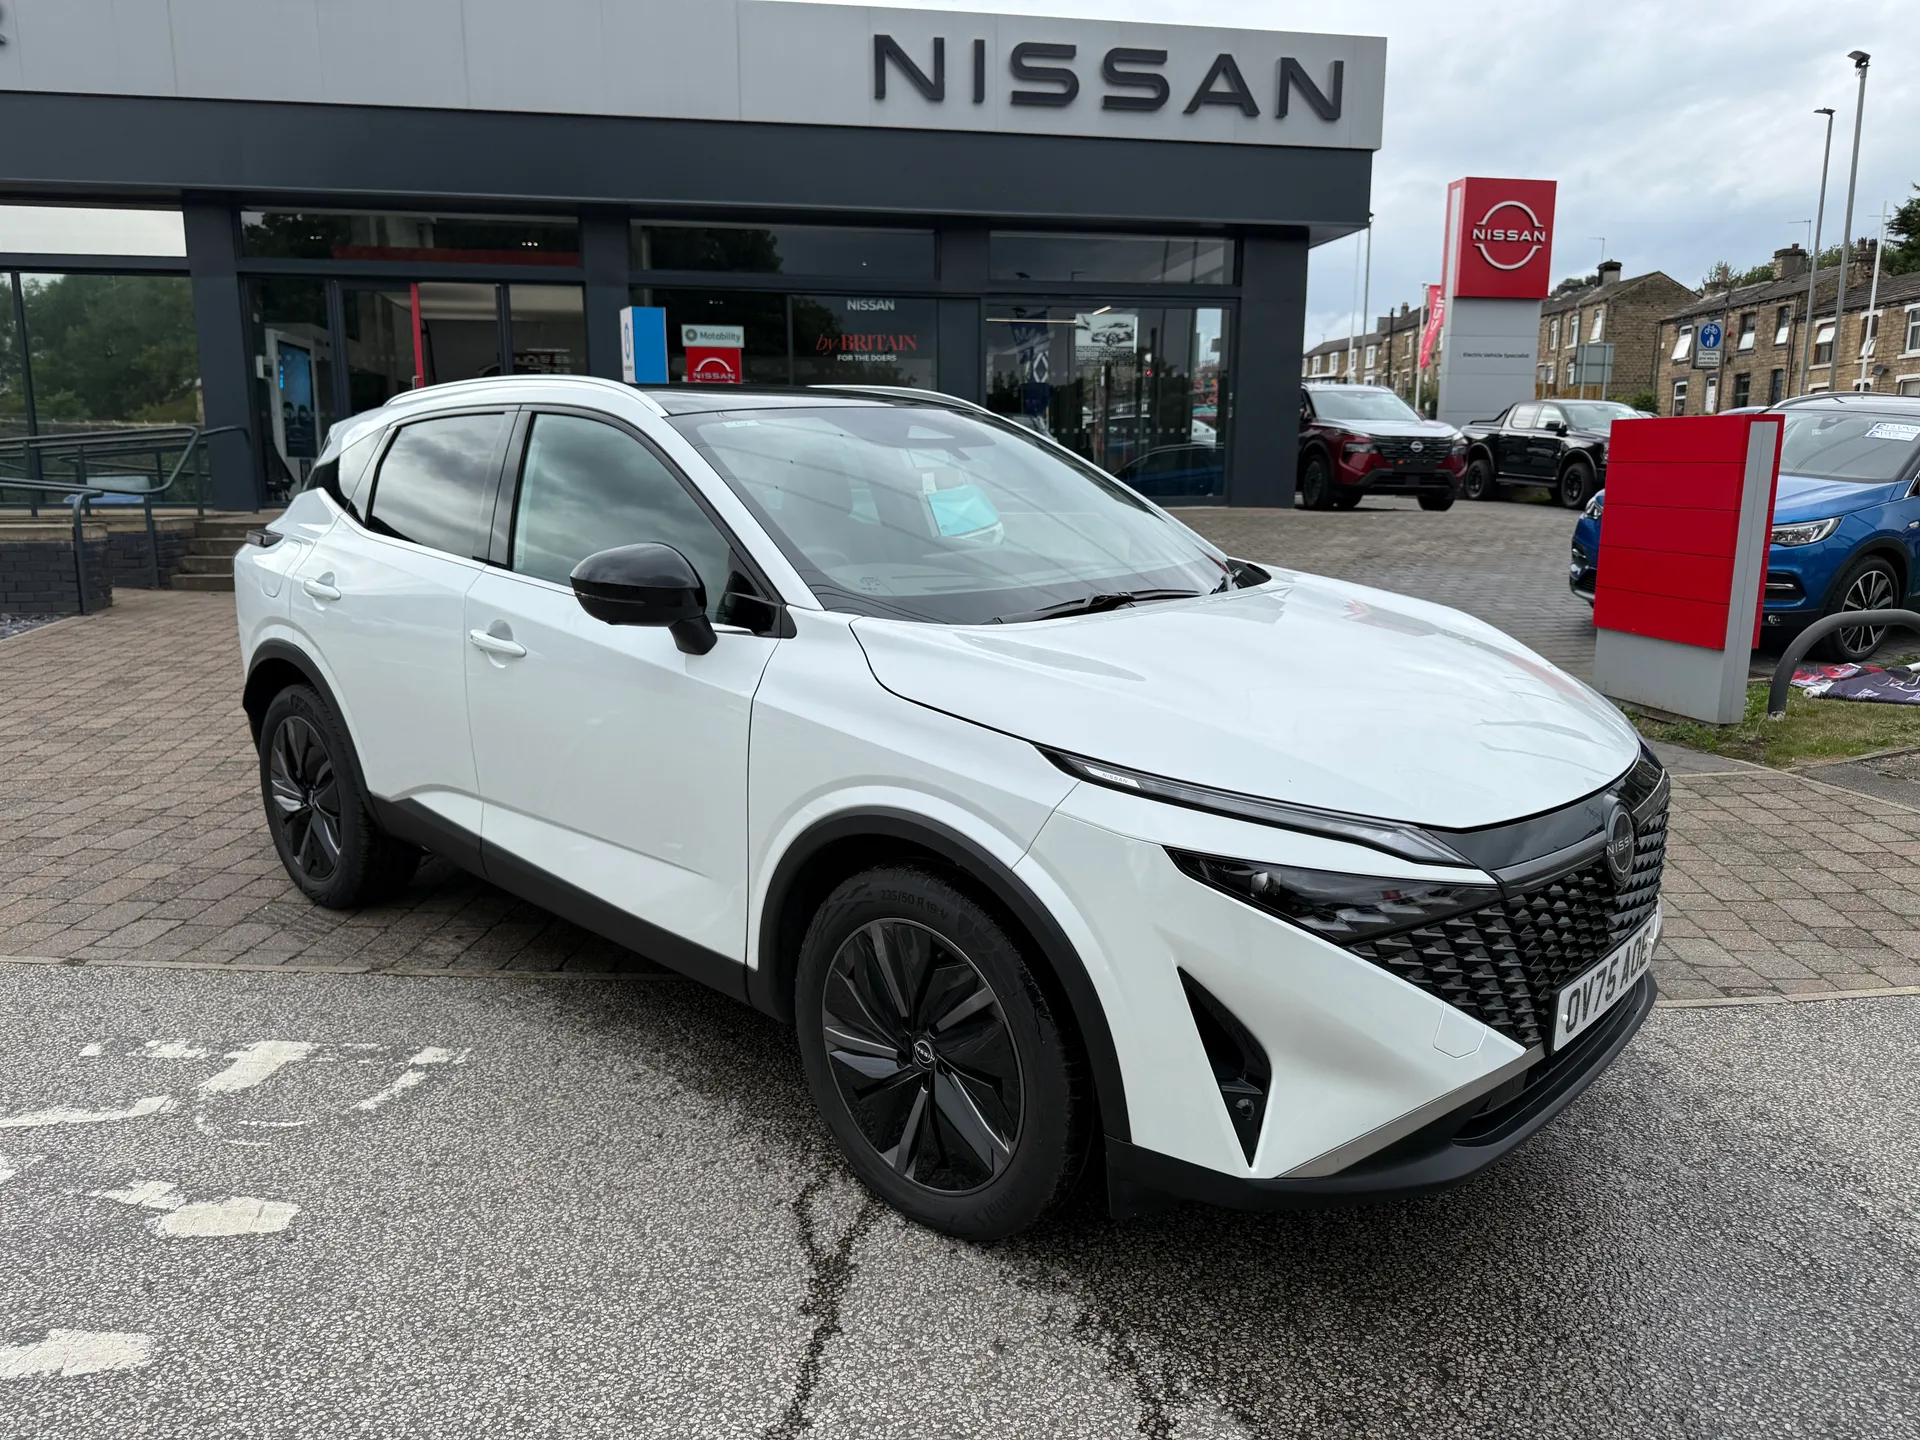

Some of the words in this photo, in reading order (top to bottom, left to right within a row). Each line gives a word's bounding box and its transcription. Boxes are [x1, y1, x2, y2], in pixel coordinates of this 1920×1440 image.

[873, 33, 1345, 122] NISSAN
[1472, 228, 1546, 242] NISSAN
[846, 299, 895, 311] NISSAN
[815, 333, 839, 355] by
[841, 334, 918, 351] BRITAIN
[837, 354, 854, 362] FOR
[855, 354, 870, 362] THE
[870, 354, 897, 362] DOERS
[1503, 352, 1530, 360] Specialist
[693, 372, 736, 380] NISSAN
[1101, 772, 1129, 784] NISSAN
[1566, 956, 1620, 1034] OV75
